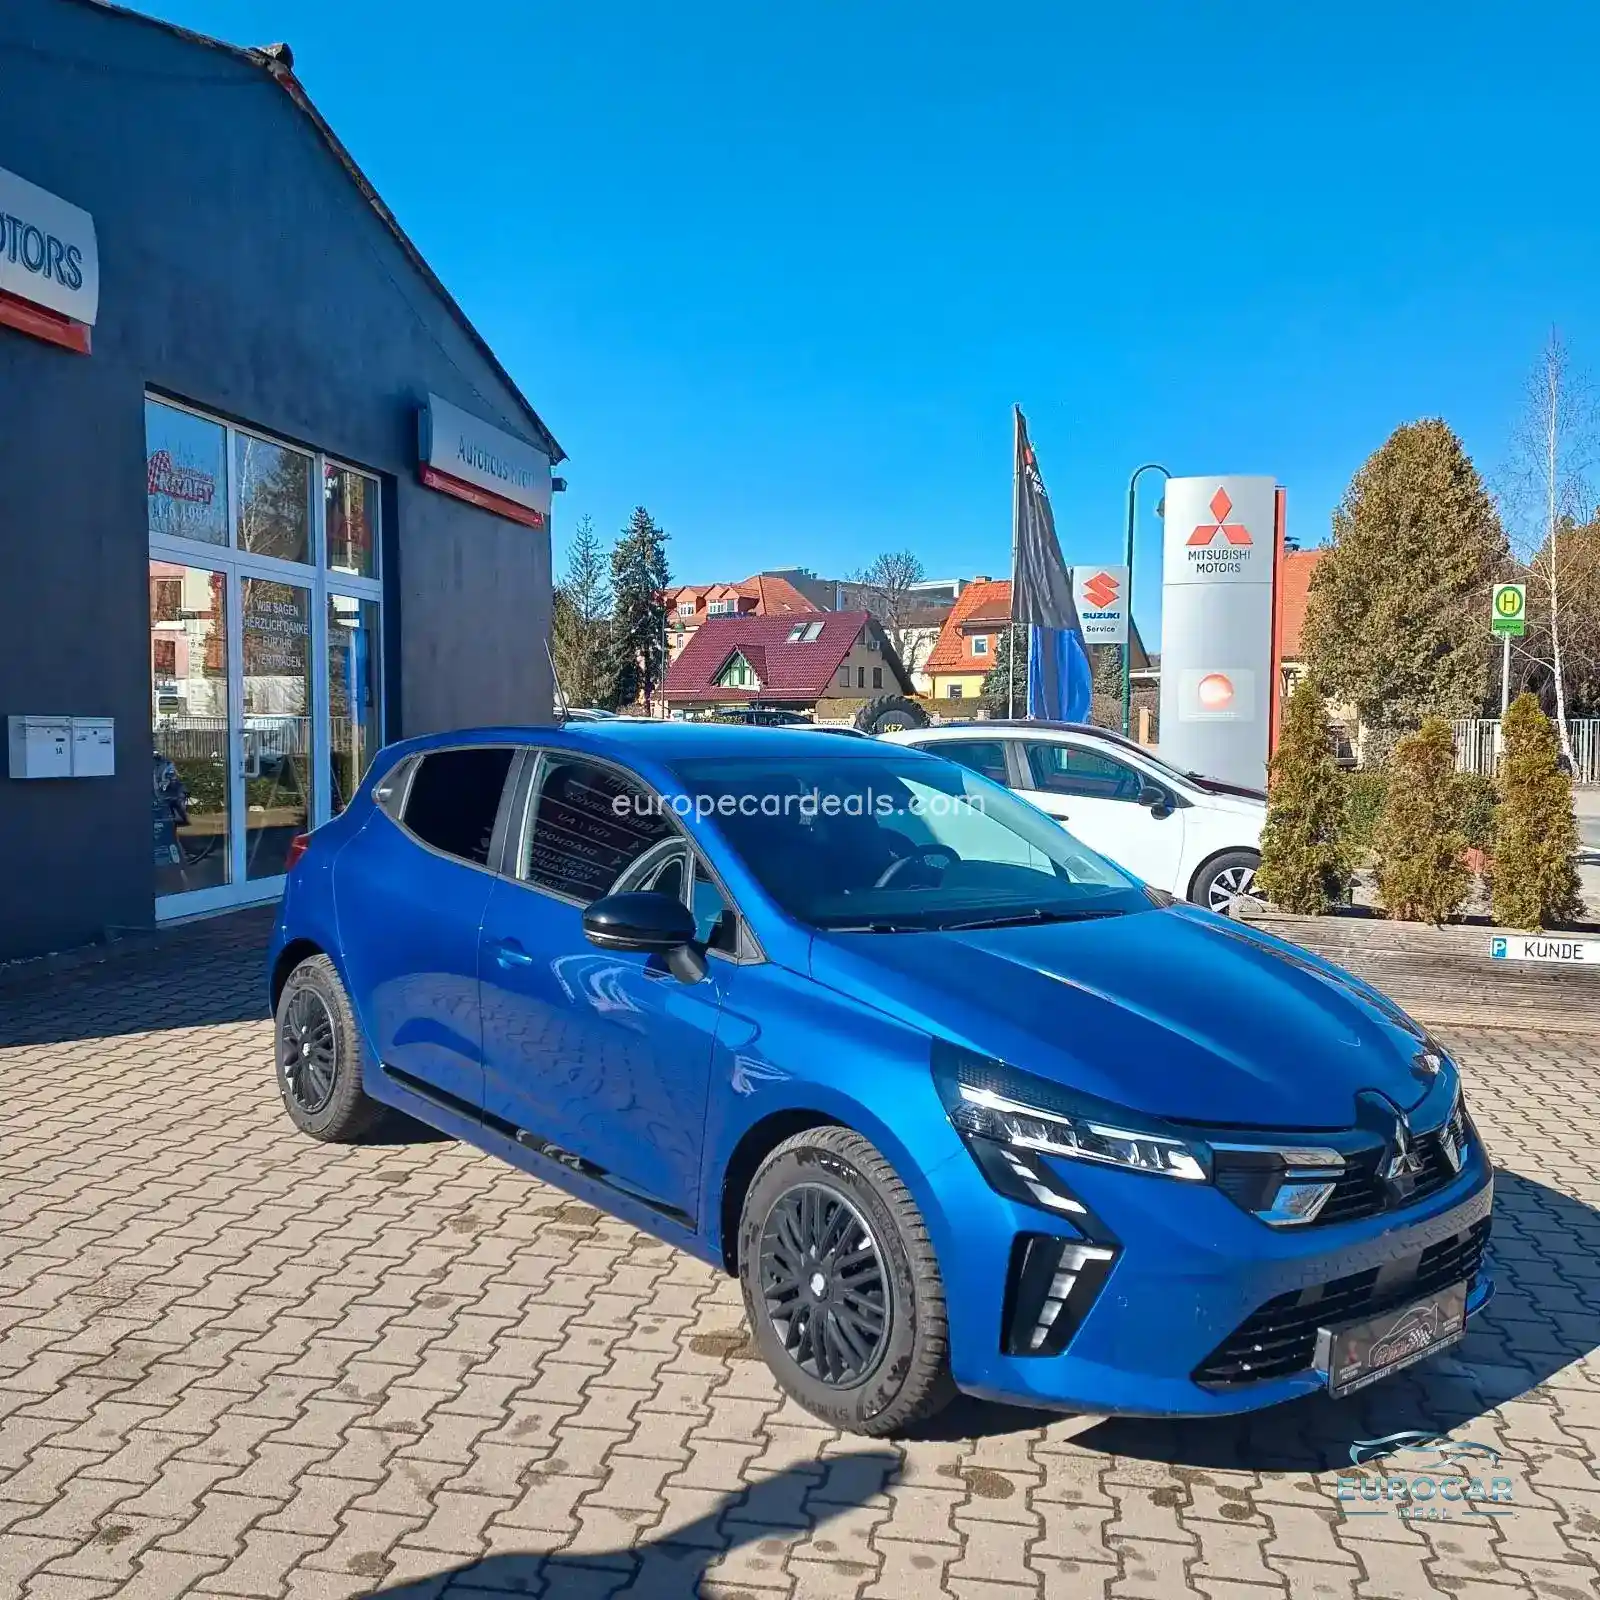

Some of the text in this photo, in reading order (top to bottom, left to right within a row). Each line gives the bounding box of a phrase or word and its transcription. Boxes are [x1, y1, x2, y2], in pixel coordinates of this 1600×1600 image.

[0, 211, 83, 291] TORS
[1188, 550, 1251, 560] MITSUBISHI
[1196, 562, 1241, 573] MOTORS
[1503, 593, 1515, 611] H
[283, 620, 309, 635] DANKE
[1493, 940, 1584, 960] P KUNDE
